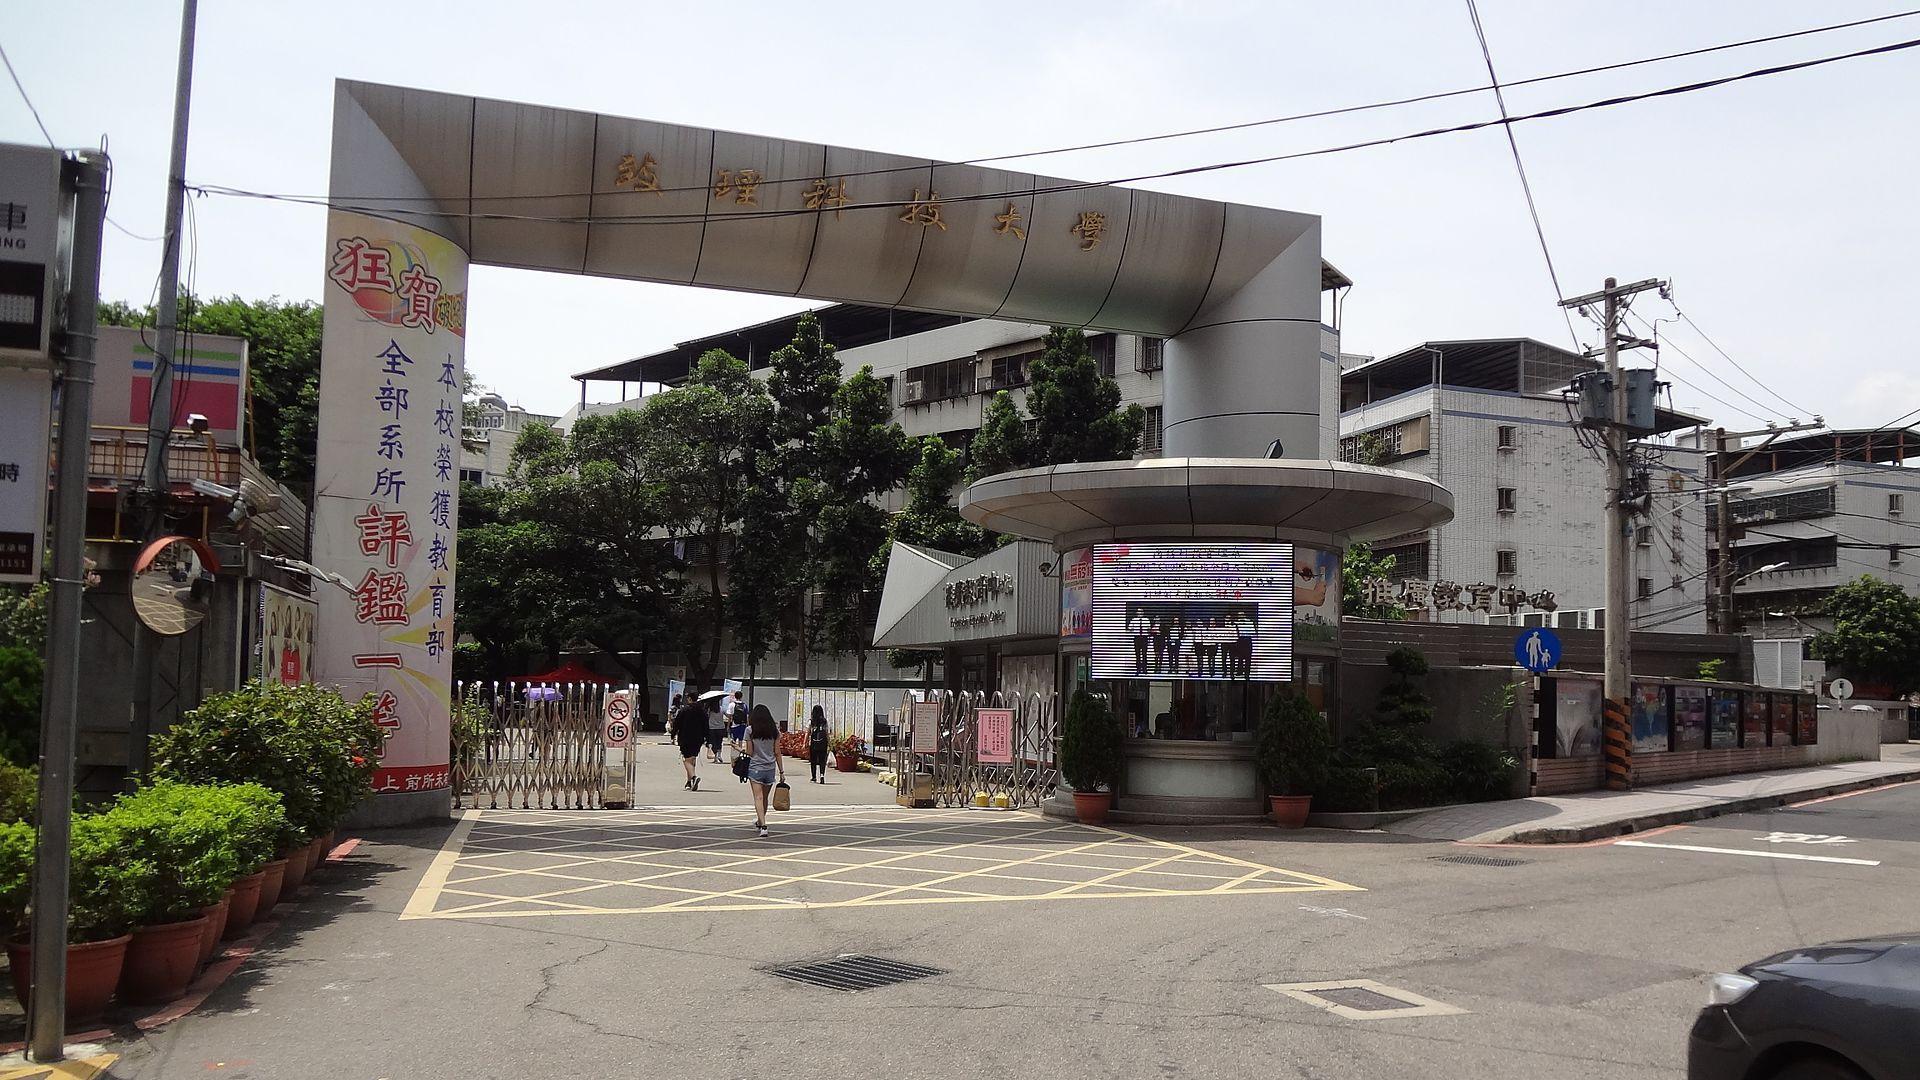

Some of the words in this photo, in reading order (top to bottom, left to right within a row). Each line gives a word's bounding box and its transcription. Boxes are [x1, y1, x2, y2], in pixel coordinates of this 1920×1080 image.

[615, 151, 1106, 252] 致理科技大學
[330, 238, 440, 333] 狂賀
[425, 353, 457, 663] 本校榮獲教育部
[1361, 575, 1558, 614] 推廣教育中心
[611, 726, 625, 738] 15
